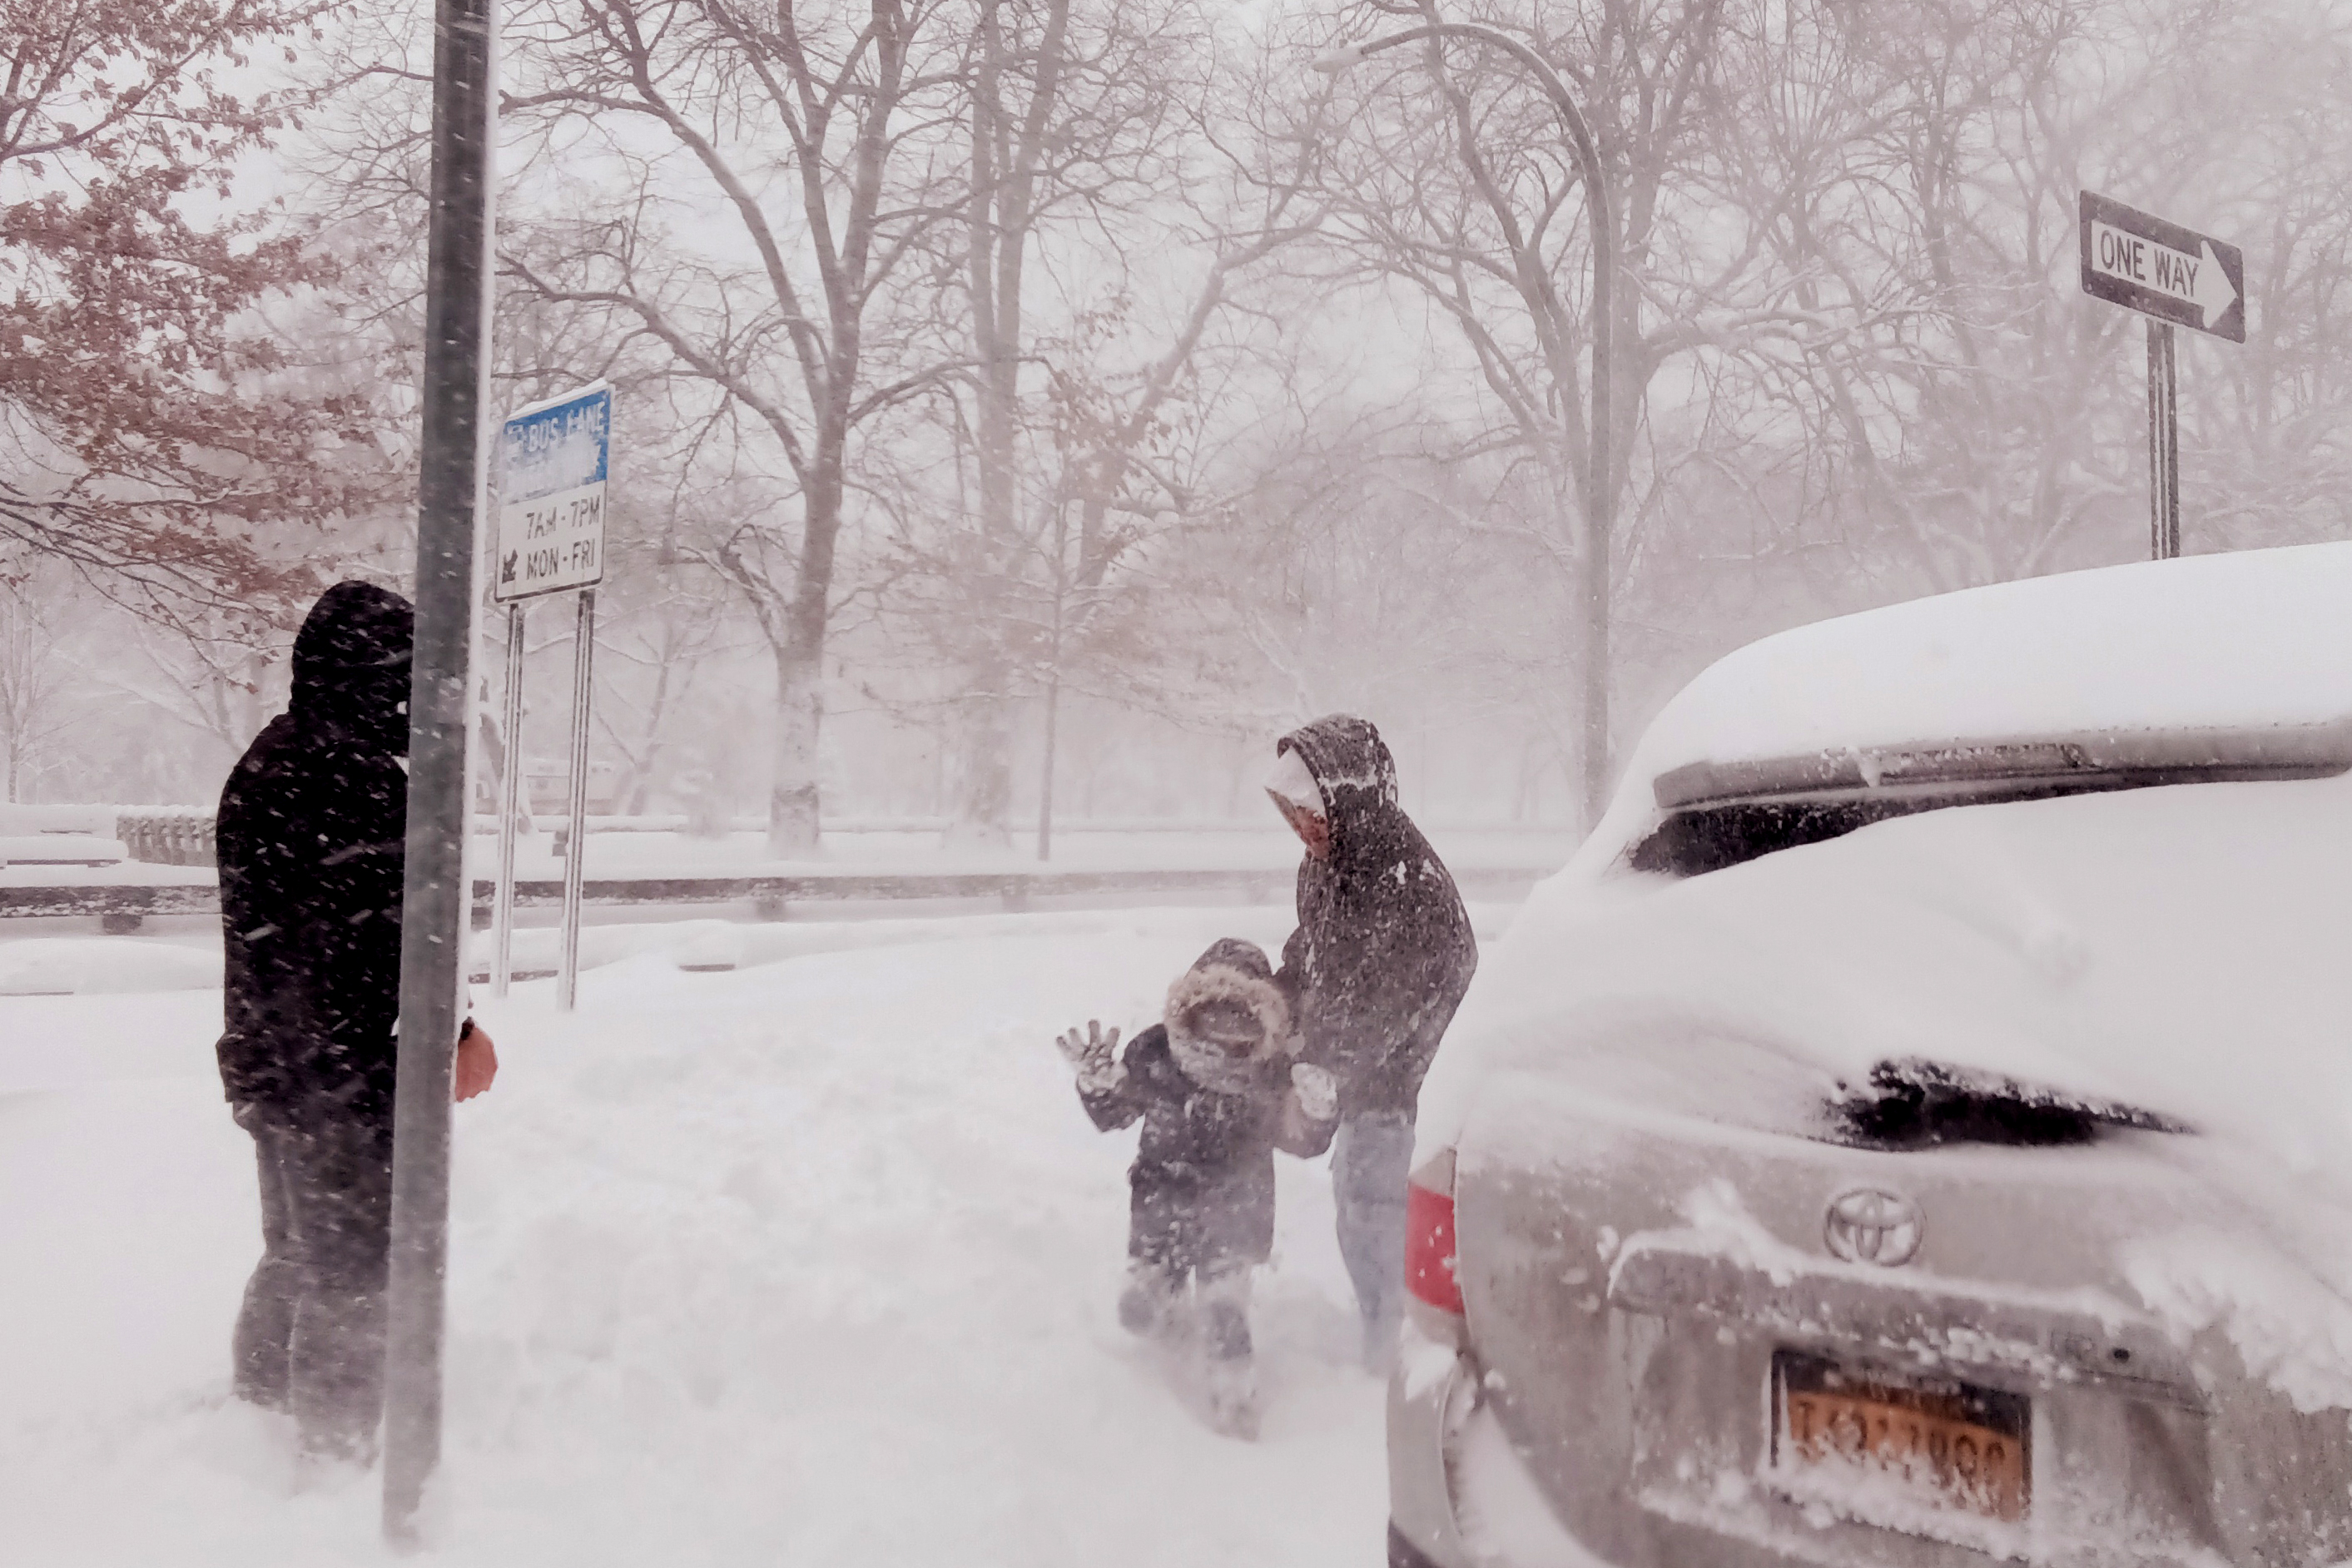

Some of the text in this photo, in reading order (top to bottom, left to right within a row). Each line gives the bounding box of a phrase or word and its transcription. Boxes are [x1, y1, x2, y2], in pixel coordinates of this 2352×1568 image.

[2100, 229, 2200, 298] ONE WAY
[528, 417, 558, 453] BUS
[526, 545, 559, 581] MON
[572, 538, 596, 571] FRI
